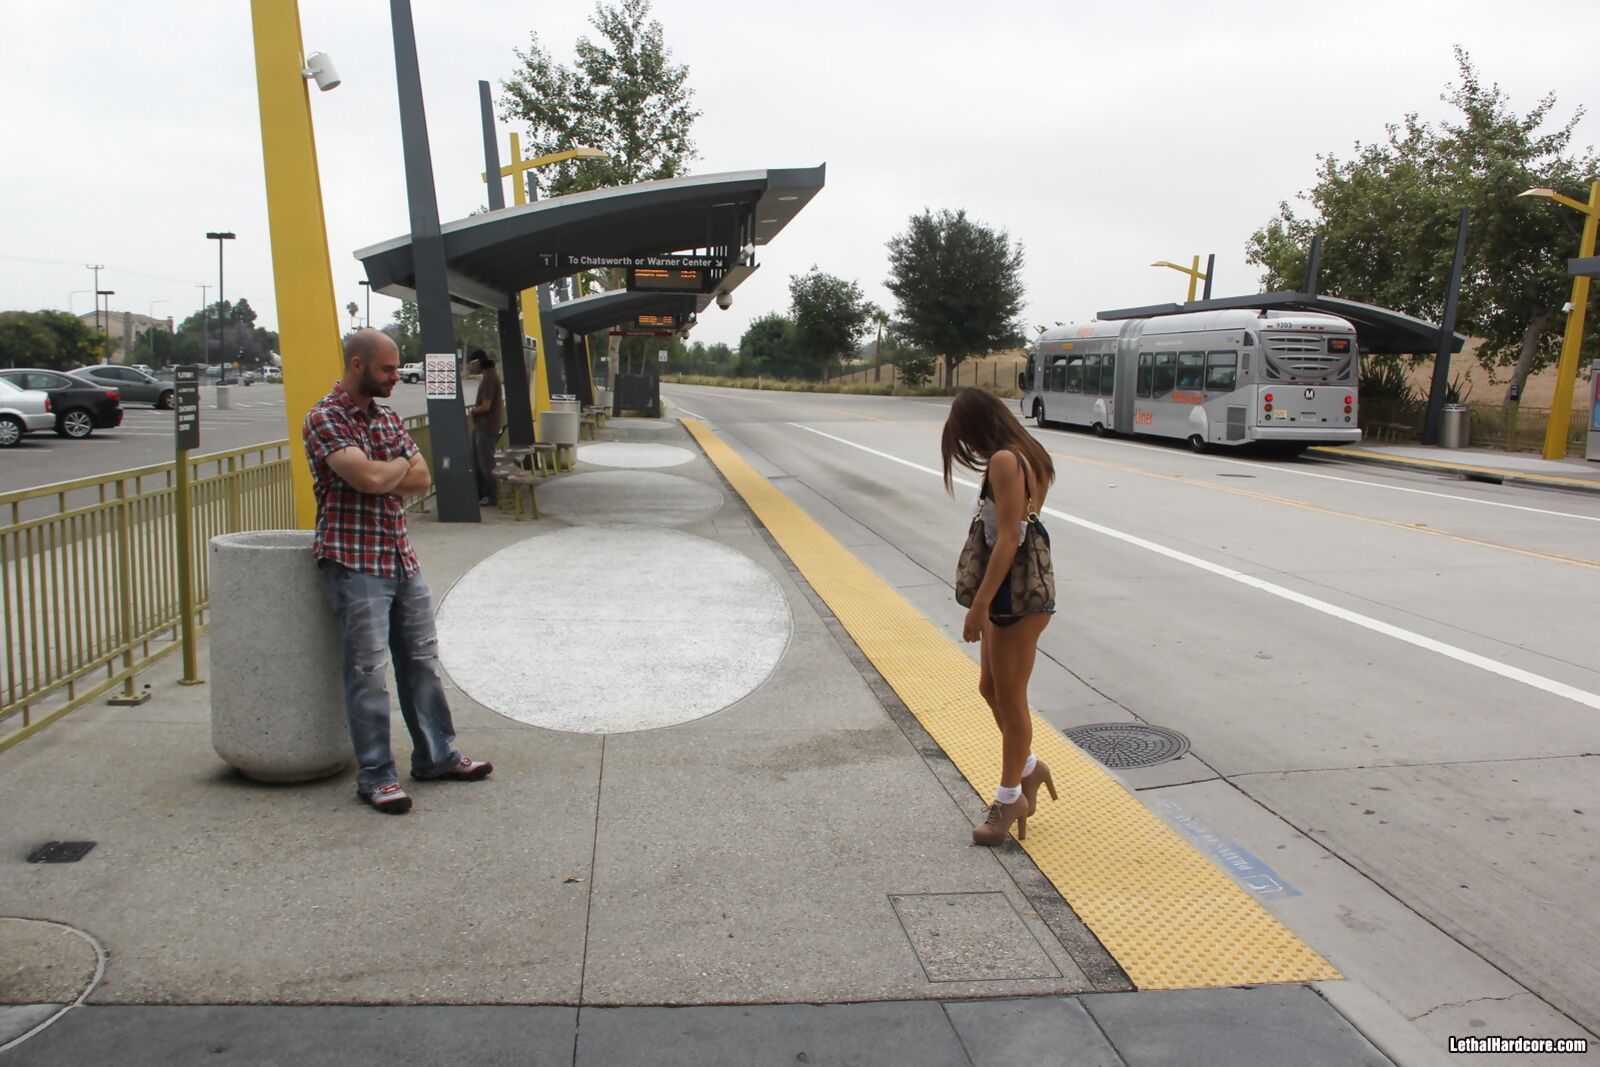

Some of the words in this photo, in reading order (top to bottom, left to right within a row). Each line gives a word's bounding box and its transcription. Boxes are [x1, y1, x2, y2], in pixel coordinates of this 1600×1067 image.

[544, 257, 549, 266] 1
[568, 255, 579, 265] To
[580, 255, 632, 266] Chatsworth
[634, 257, 644, 266] or
[647, 257, 680, 266] Warner
[682, 257, 712, 267] Center
[1304, 390, 1315, 399] M
